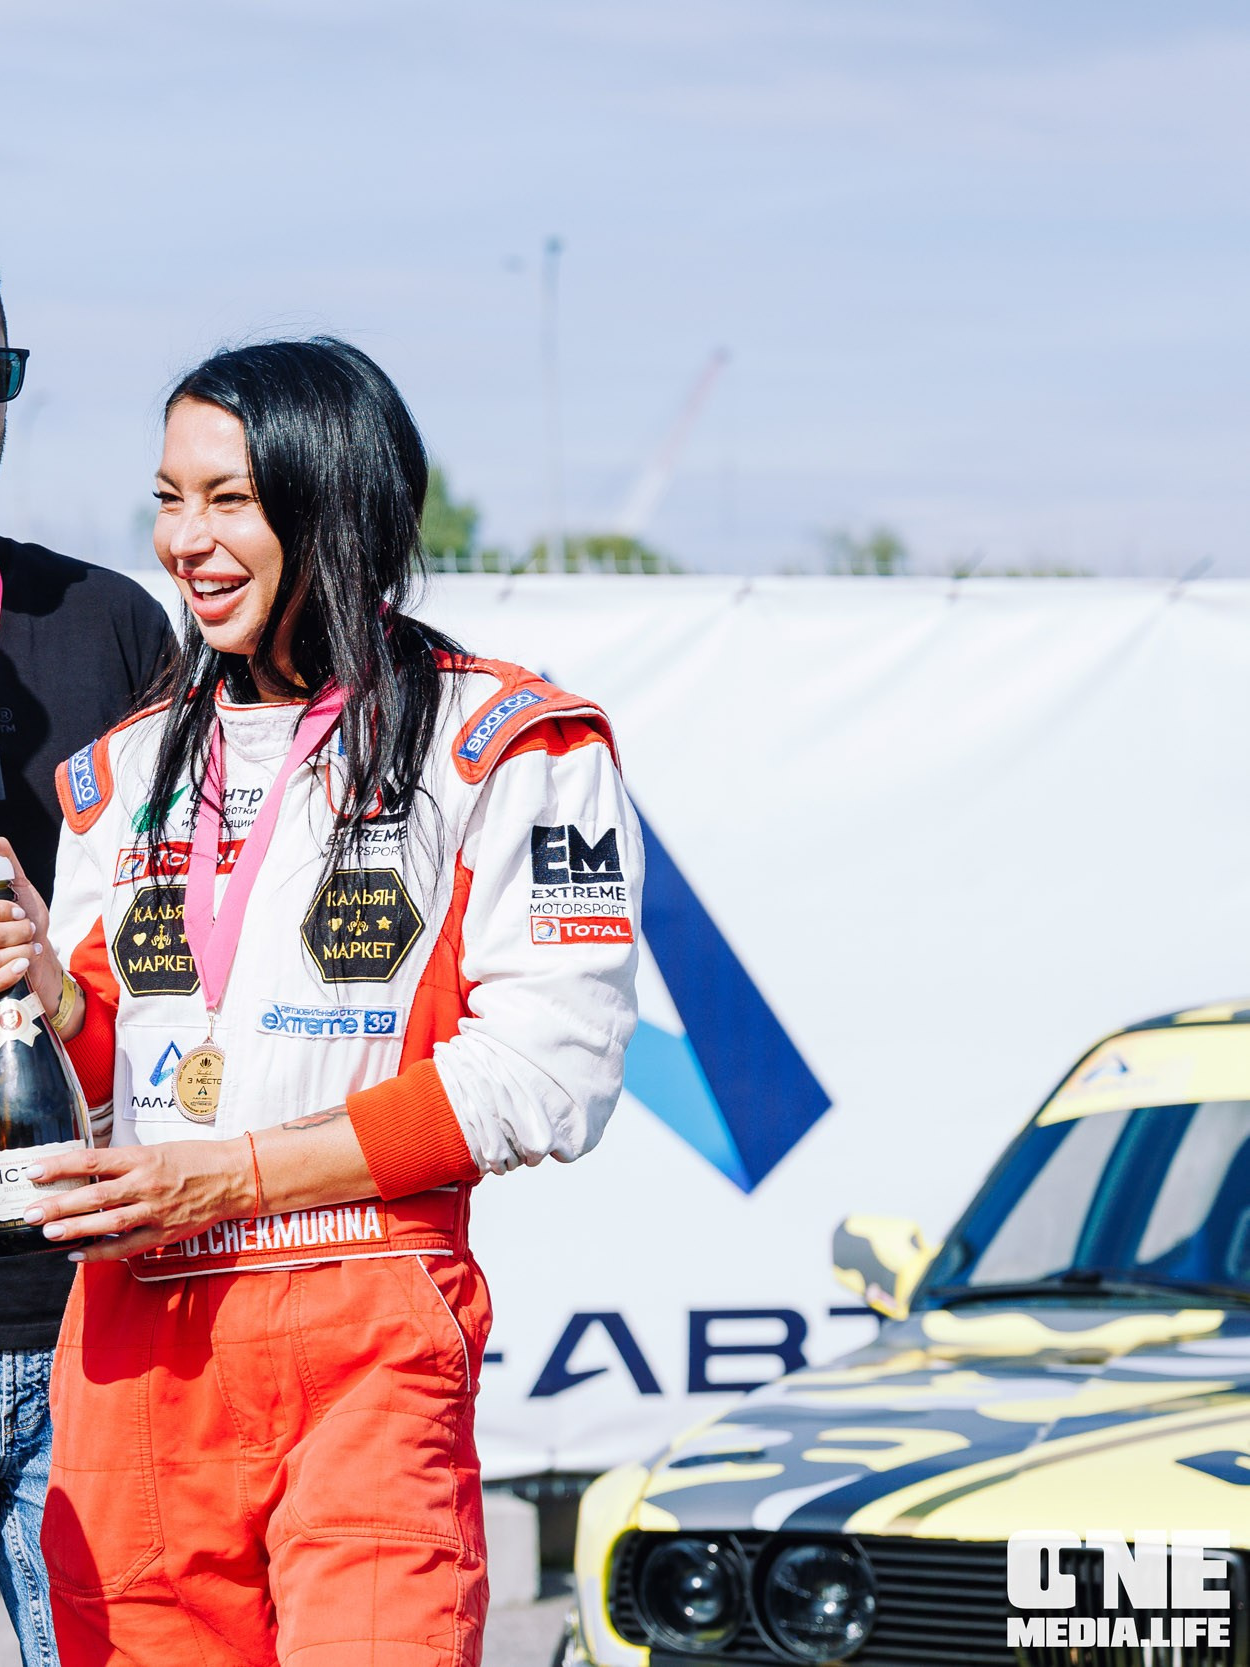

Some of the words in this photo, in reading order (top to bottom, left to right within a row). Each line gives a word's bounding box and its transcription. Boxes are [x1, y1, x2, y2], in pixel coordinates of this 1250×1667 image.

[466, 692, 534, 753] sparco
[72, 747, 95, 803] parco
[190, 787, 264, 807] Цнтр
[531, 824, 625, 885] EM
[326, 888, 397, 907] КАЛЬЯН
[531, 886, 626, 901] EXTREME
[134, 904, 185, 923] КАЛЬЯ
[530, 903, 626, 917] MOTORSPORT
[560, 922, 630, 937] TOTAL
[323, 942, 396, 961] МАРКЕТ
[128, 954, 194, 974] МАРКЕТ
[369, 1013, 393, 1032] 39
[131, 1096, 177, 1109] ЛАЛ-А
